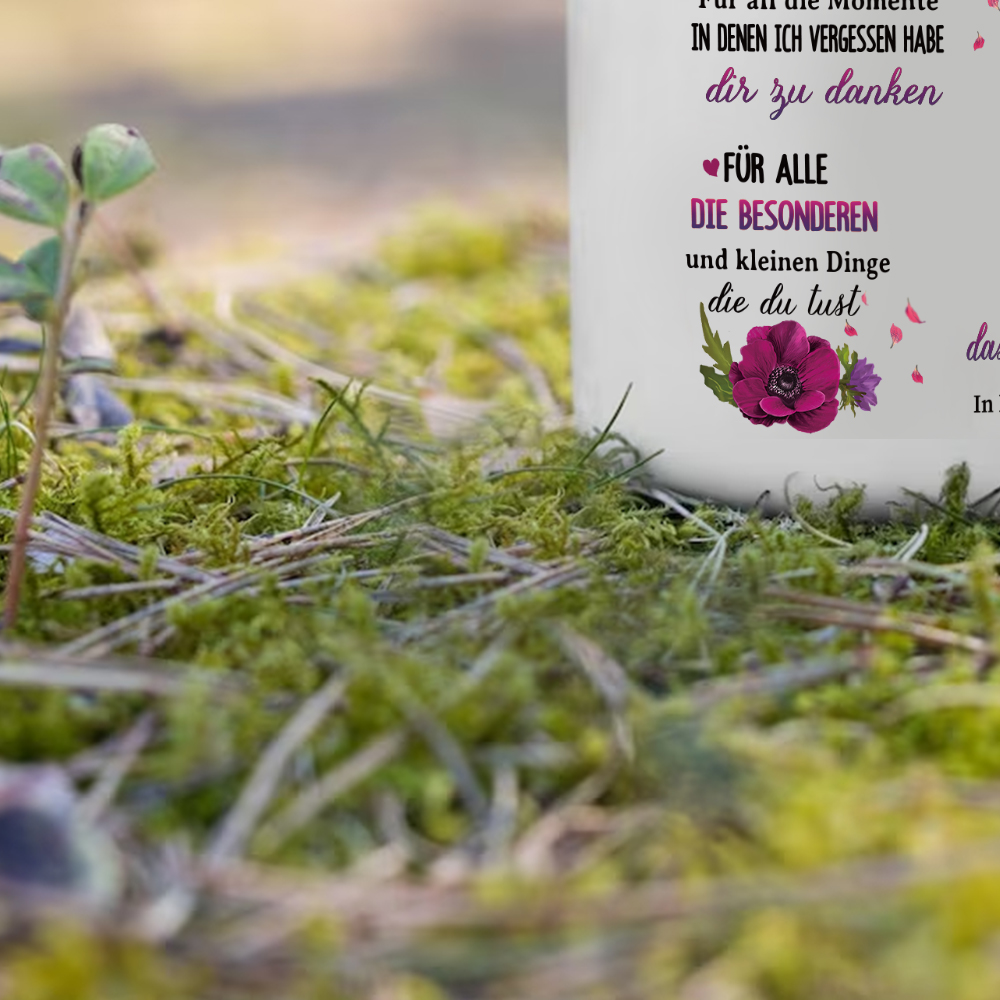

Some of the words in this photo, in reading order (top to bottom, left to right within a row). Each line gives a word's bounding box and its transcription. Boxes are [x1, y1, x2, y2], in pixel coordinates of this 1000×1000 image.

[691, 23, 710, 51] IN
[718, 23, 767, 52] DENEN
[774, 24, 802, 53] ICH
[809, 24, 896, 53] VERGESSEN
[904, 24, 944, 54] HABE
[706, 67, 758, 103] dir
[770, 78, 813, 120] zu
[825, 67, 943, 105] danken
[724, 145, 764, 183] FÜR
[776, 153, 828, 185] ALLE
[691, 198, 728, 229] DIE
[739, 199, 878, 232] BESONDEREN
[686, 248, 728, 270] und
[736, 248, 818, 272] kleinen
[827, 251, 890, 280] Dinge
[708, 282, 749, 313] die
[760, 283, 797, 315] du
[808, 284, 861, 316] tust
[974, 395, 994, 413] In
